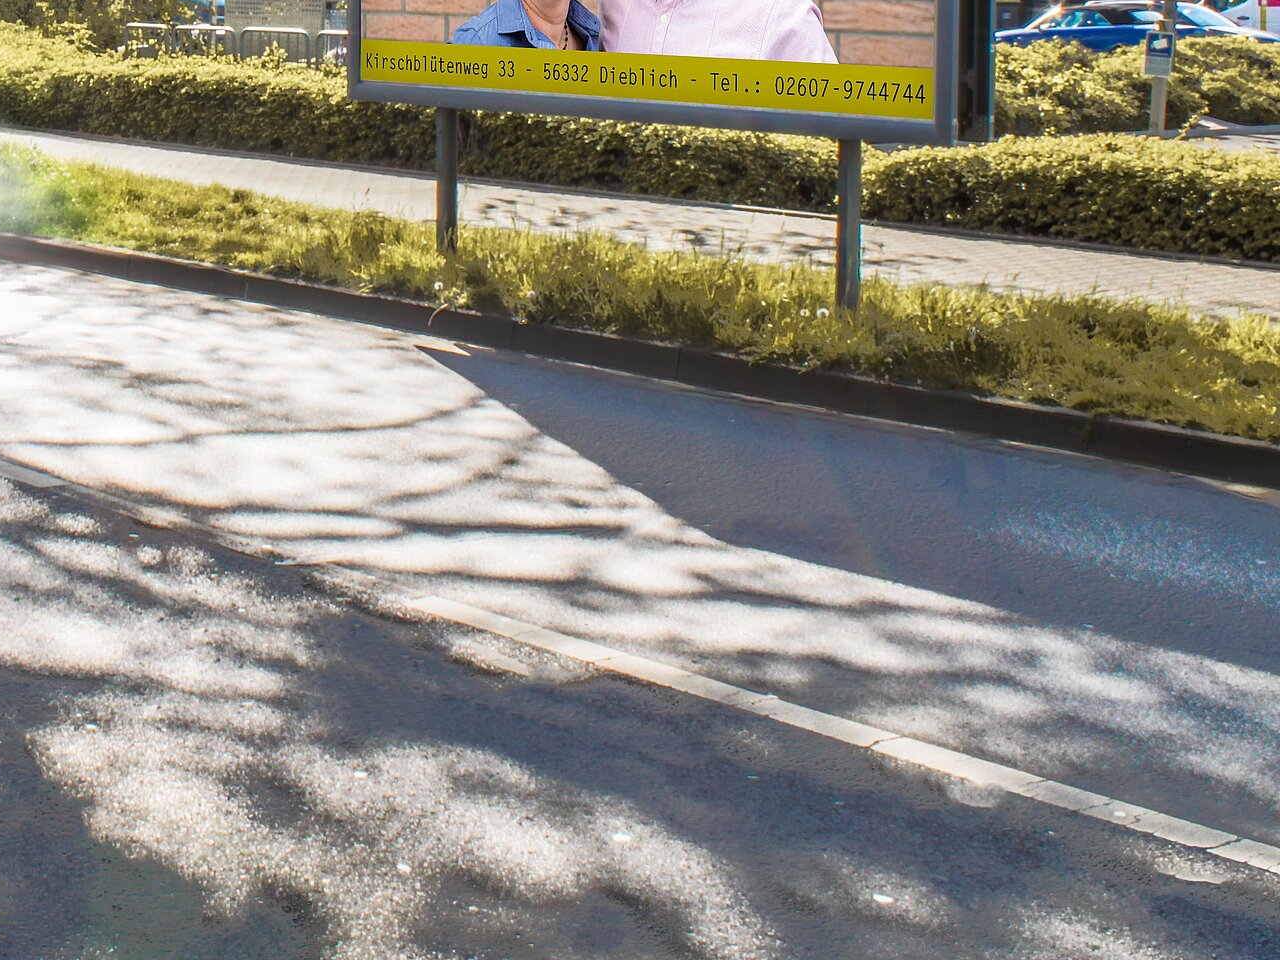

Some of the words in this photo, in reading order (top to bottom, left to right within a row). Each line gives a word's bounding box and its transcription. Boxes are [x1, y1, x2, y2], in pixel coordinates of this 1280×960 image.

[366, 52, 489, 79] Kirschblütenweg
[498, 59, 515, 78] 33
[543, 62, 589, 83] 56332
[600, 66, 678, 89] Dieblich
[709, 72, 761, 94] Tel.:
[774, 75, 926, 104] 02607-9744744
